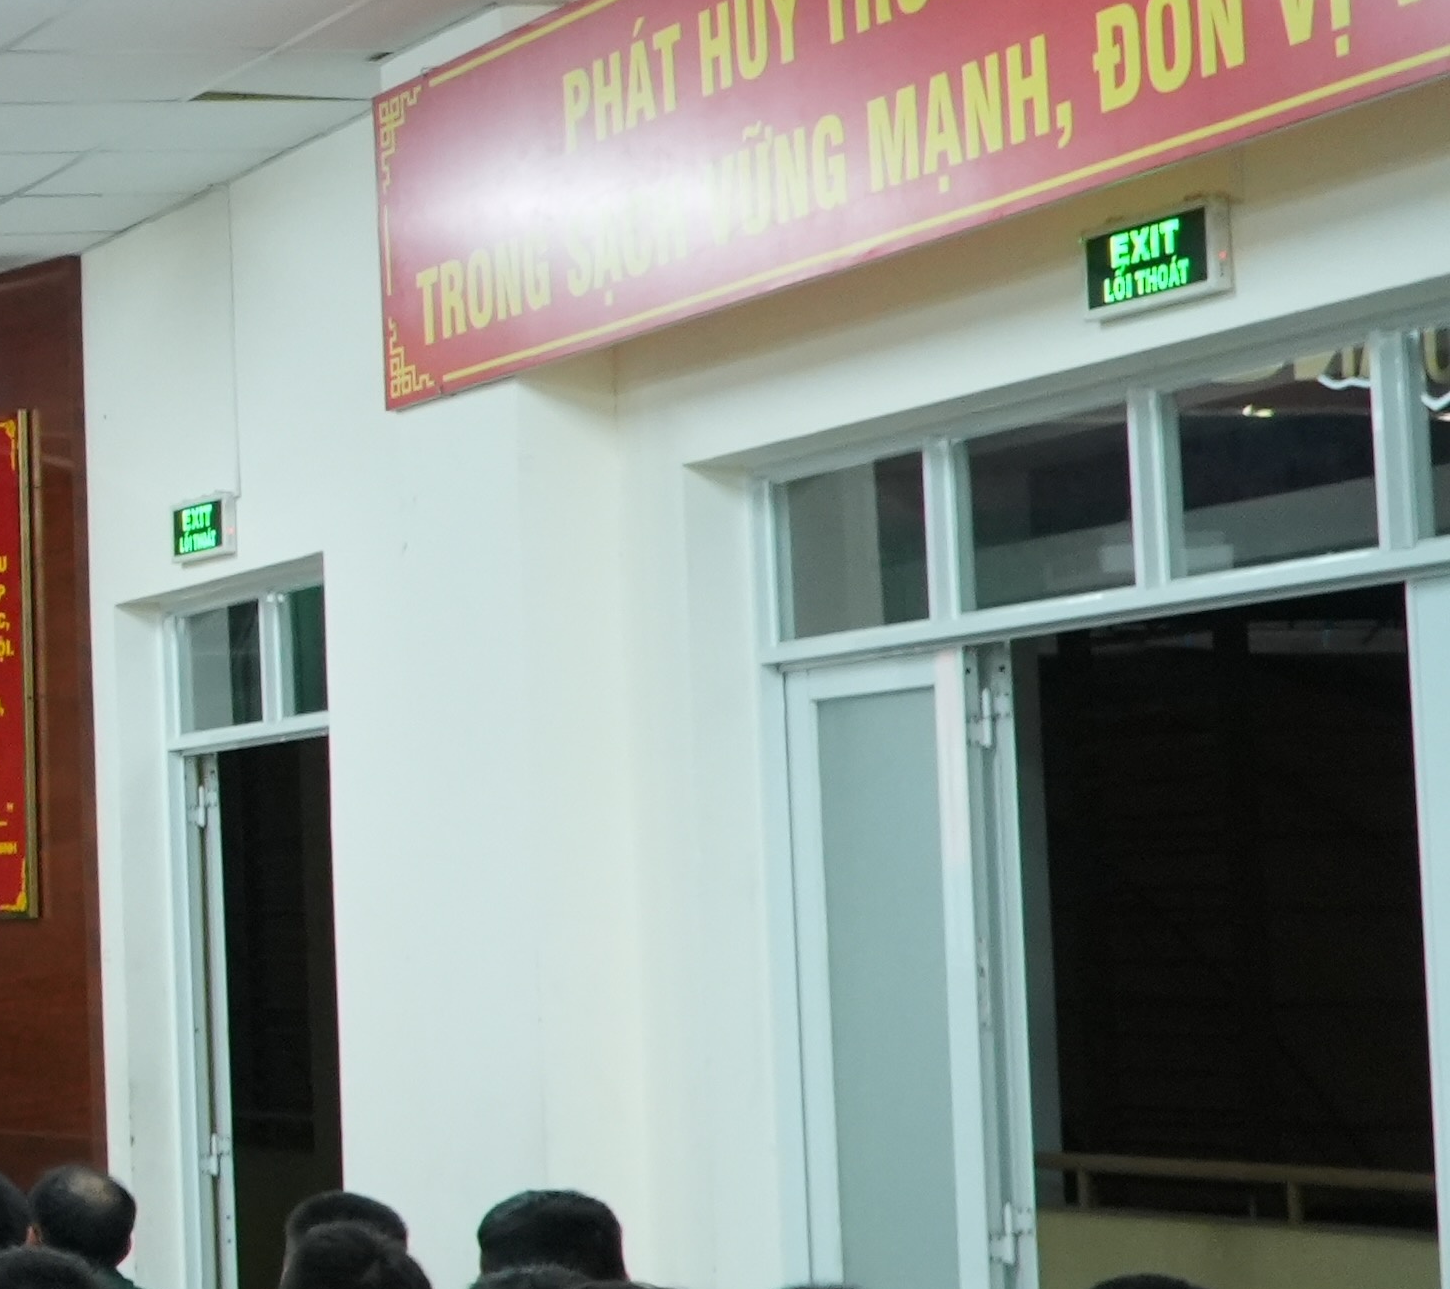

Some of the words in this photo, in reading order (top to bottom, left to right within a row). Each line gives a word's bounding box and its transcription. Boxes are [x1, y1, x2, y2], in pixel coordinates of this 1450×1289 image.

[562, 17, 681, 154] PHÁT
[416, 233, 552, 345] TRONG
[566, 173, 688, 306] SẠCH
[705, 114, 848, 245] VỮNG
[867, 34, 1073, 200] MẠNH,
[1110, 218, 1179, 269] EXIT
[1104, 264, 1133, 304] LỐI
[1134, 255, 1189, 296] THOÁT
[182, 504, 213, 533] EXIT
